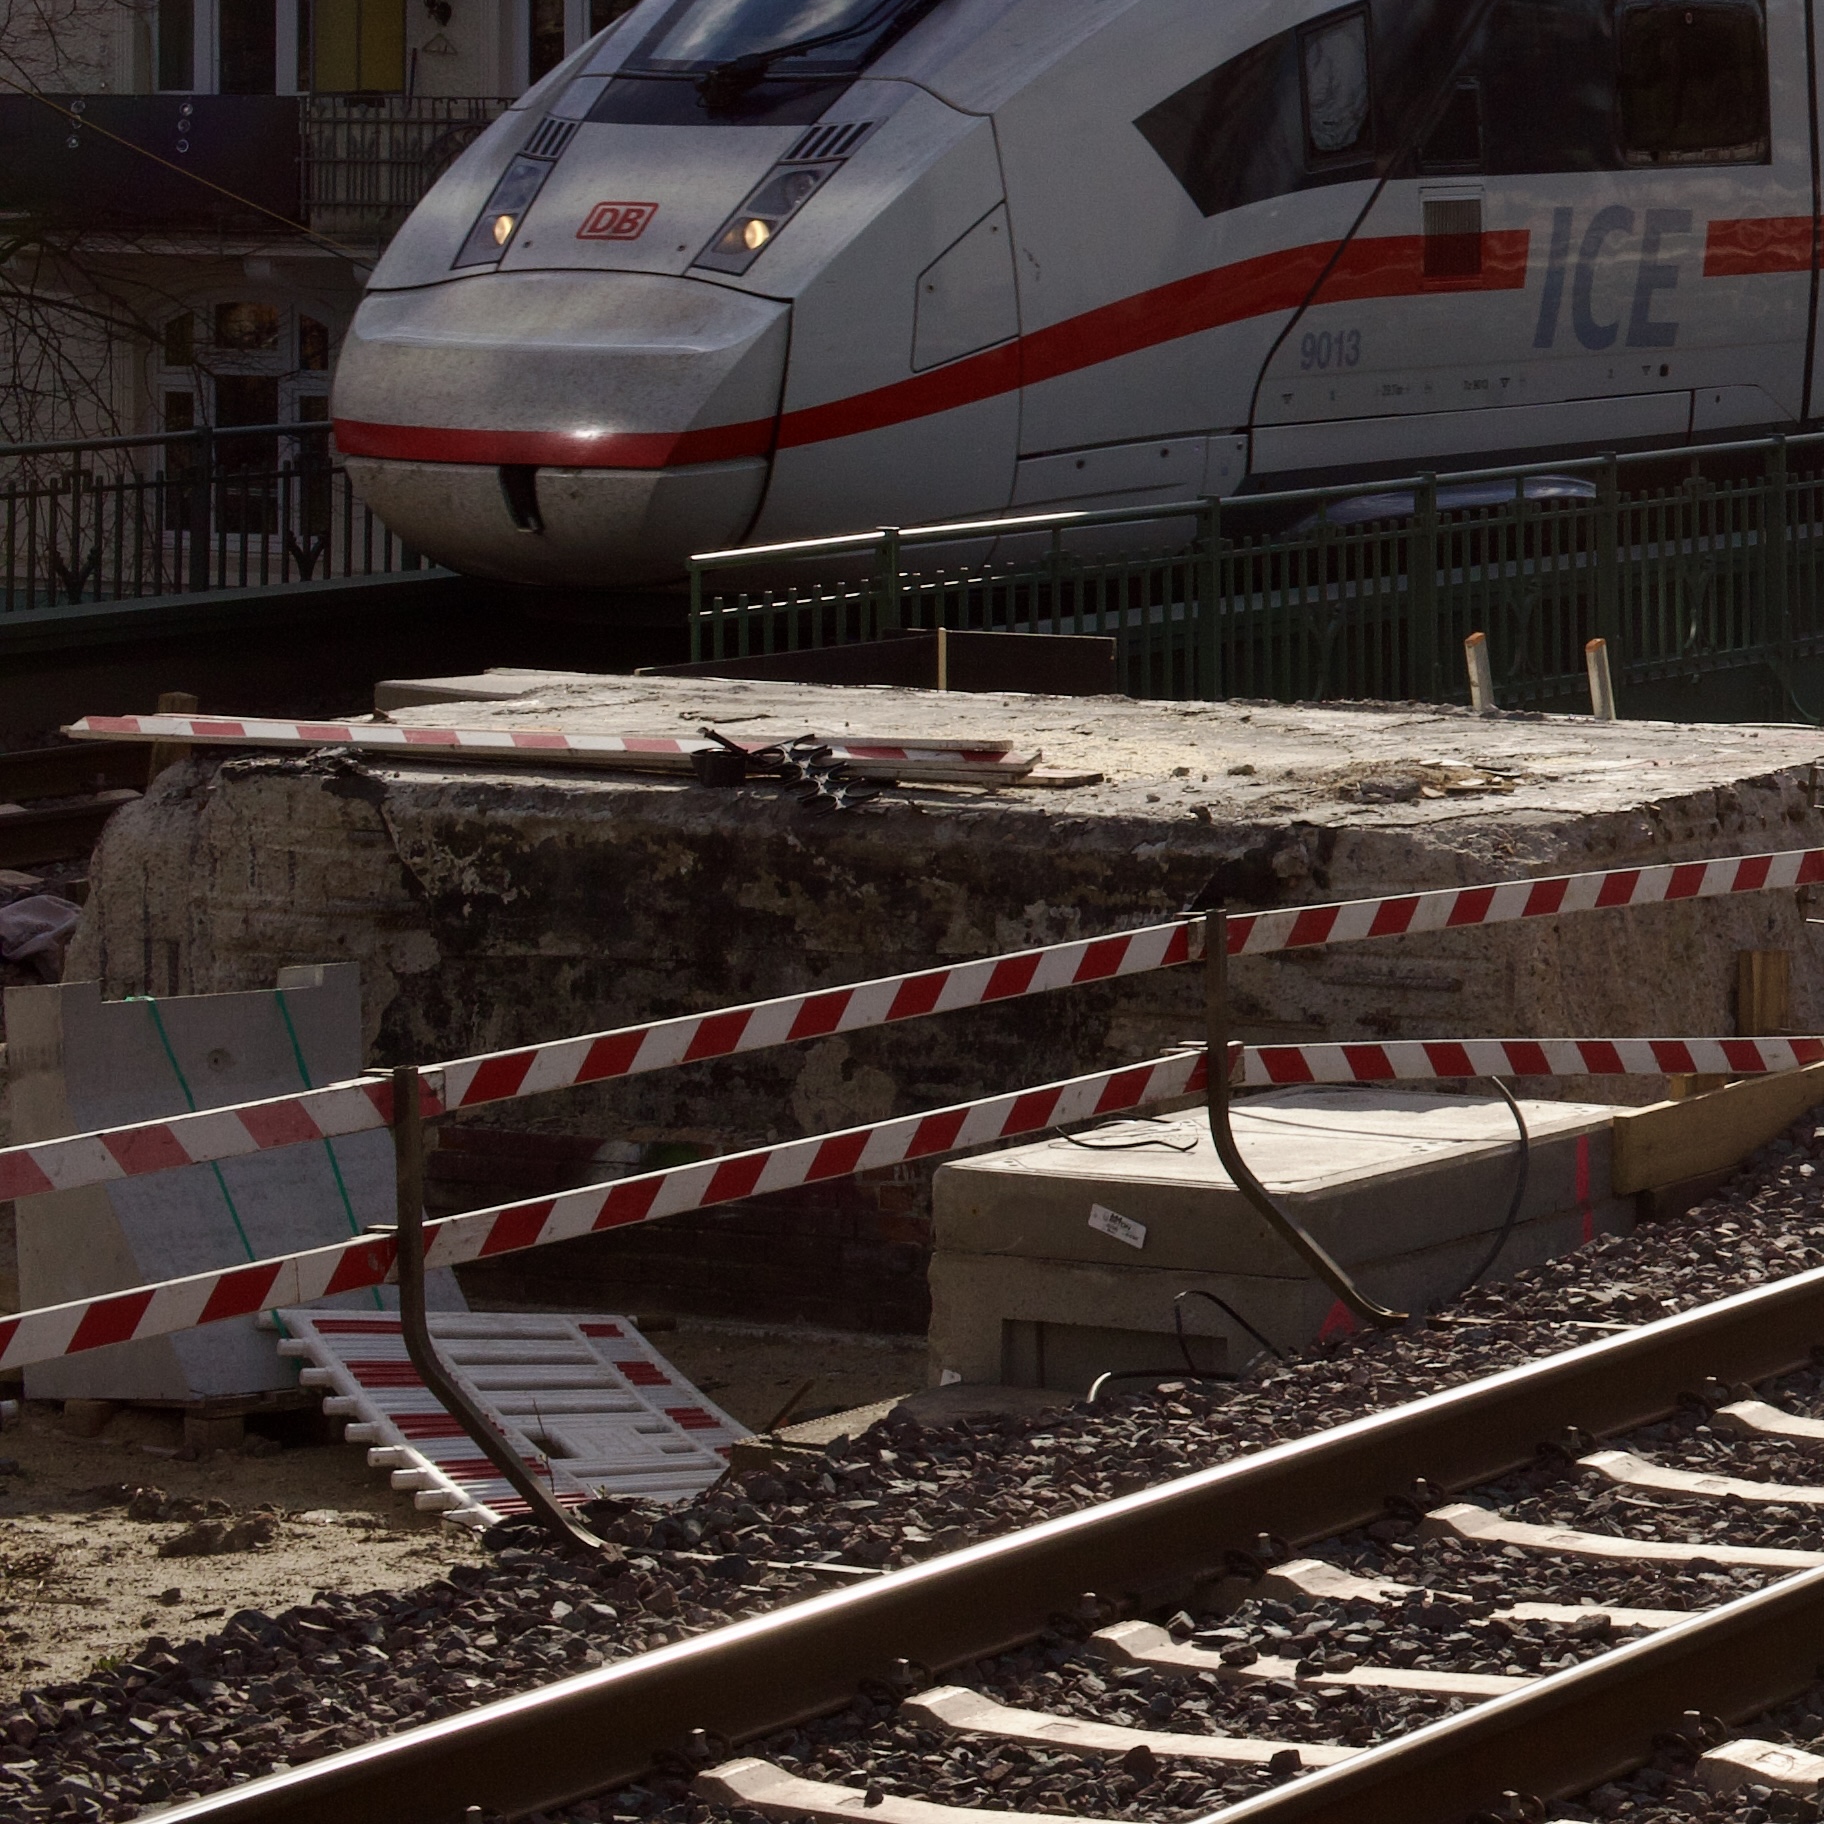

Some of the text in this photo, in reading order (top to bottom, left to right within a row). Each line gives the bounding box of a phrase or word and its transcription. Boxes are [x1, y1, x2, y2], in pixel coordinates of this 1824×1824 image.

[584, 206, 648, 235] DB
[1532, 204, 1693, 351] ICE
[1301, 329, 1361, 370] 9013
